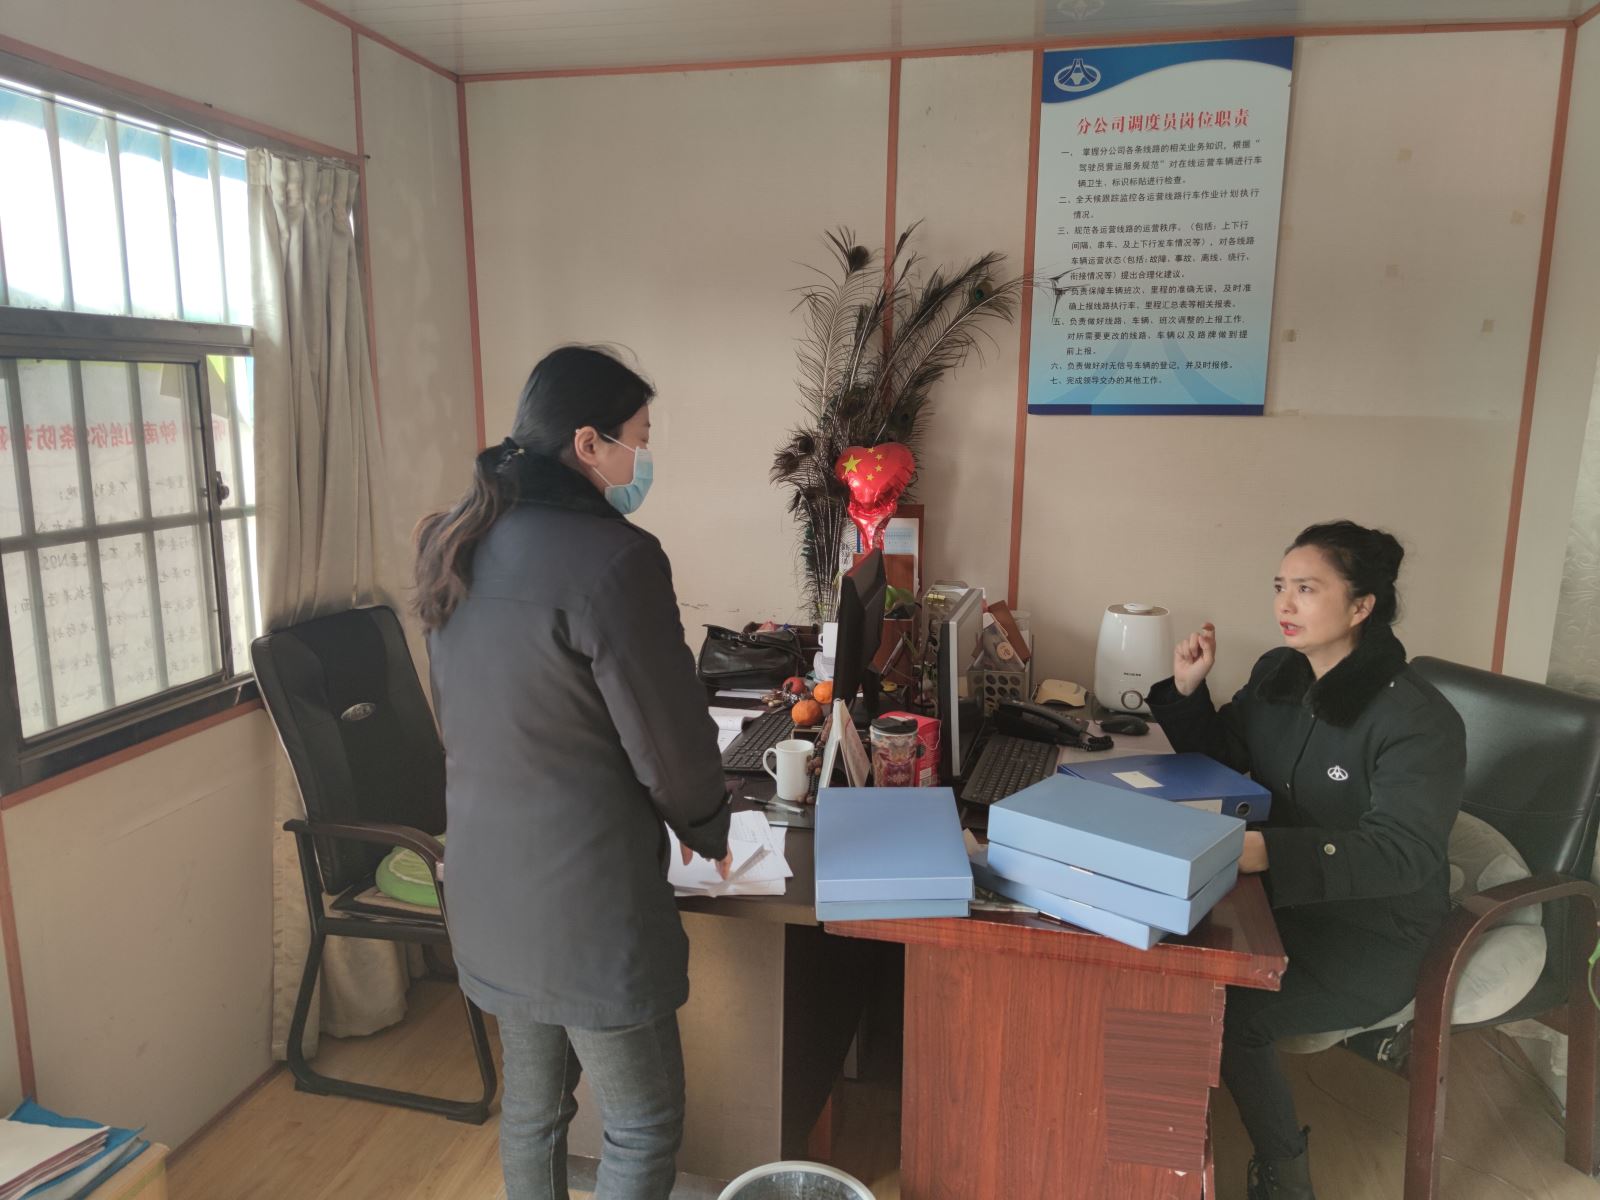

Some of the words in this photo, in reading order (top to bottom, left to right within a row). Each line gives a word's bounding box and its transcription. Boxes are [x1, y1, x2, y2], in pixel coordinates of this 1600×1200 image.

[1076, 107, 1250, 135] 分公司调度员岗位职责
